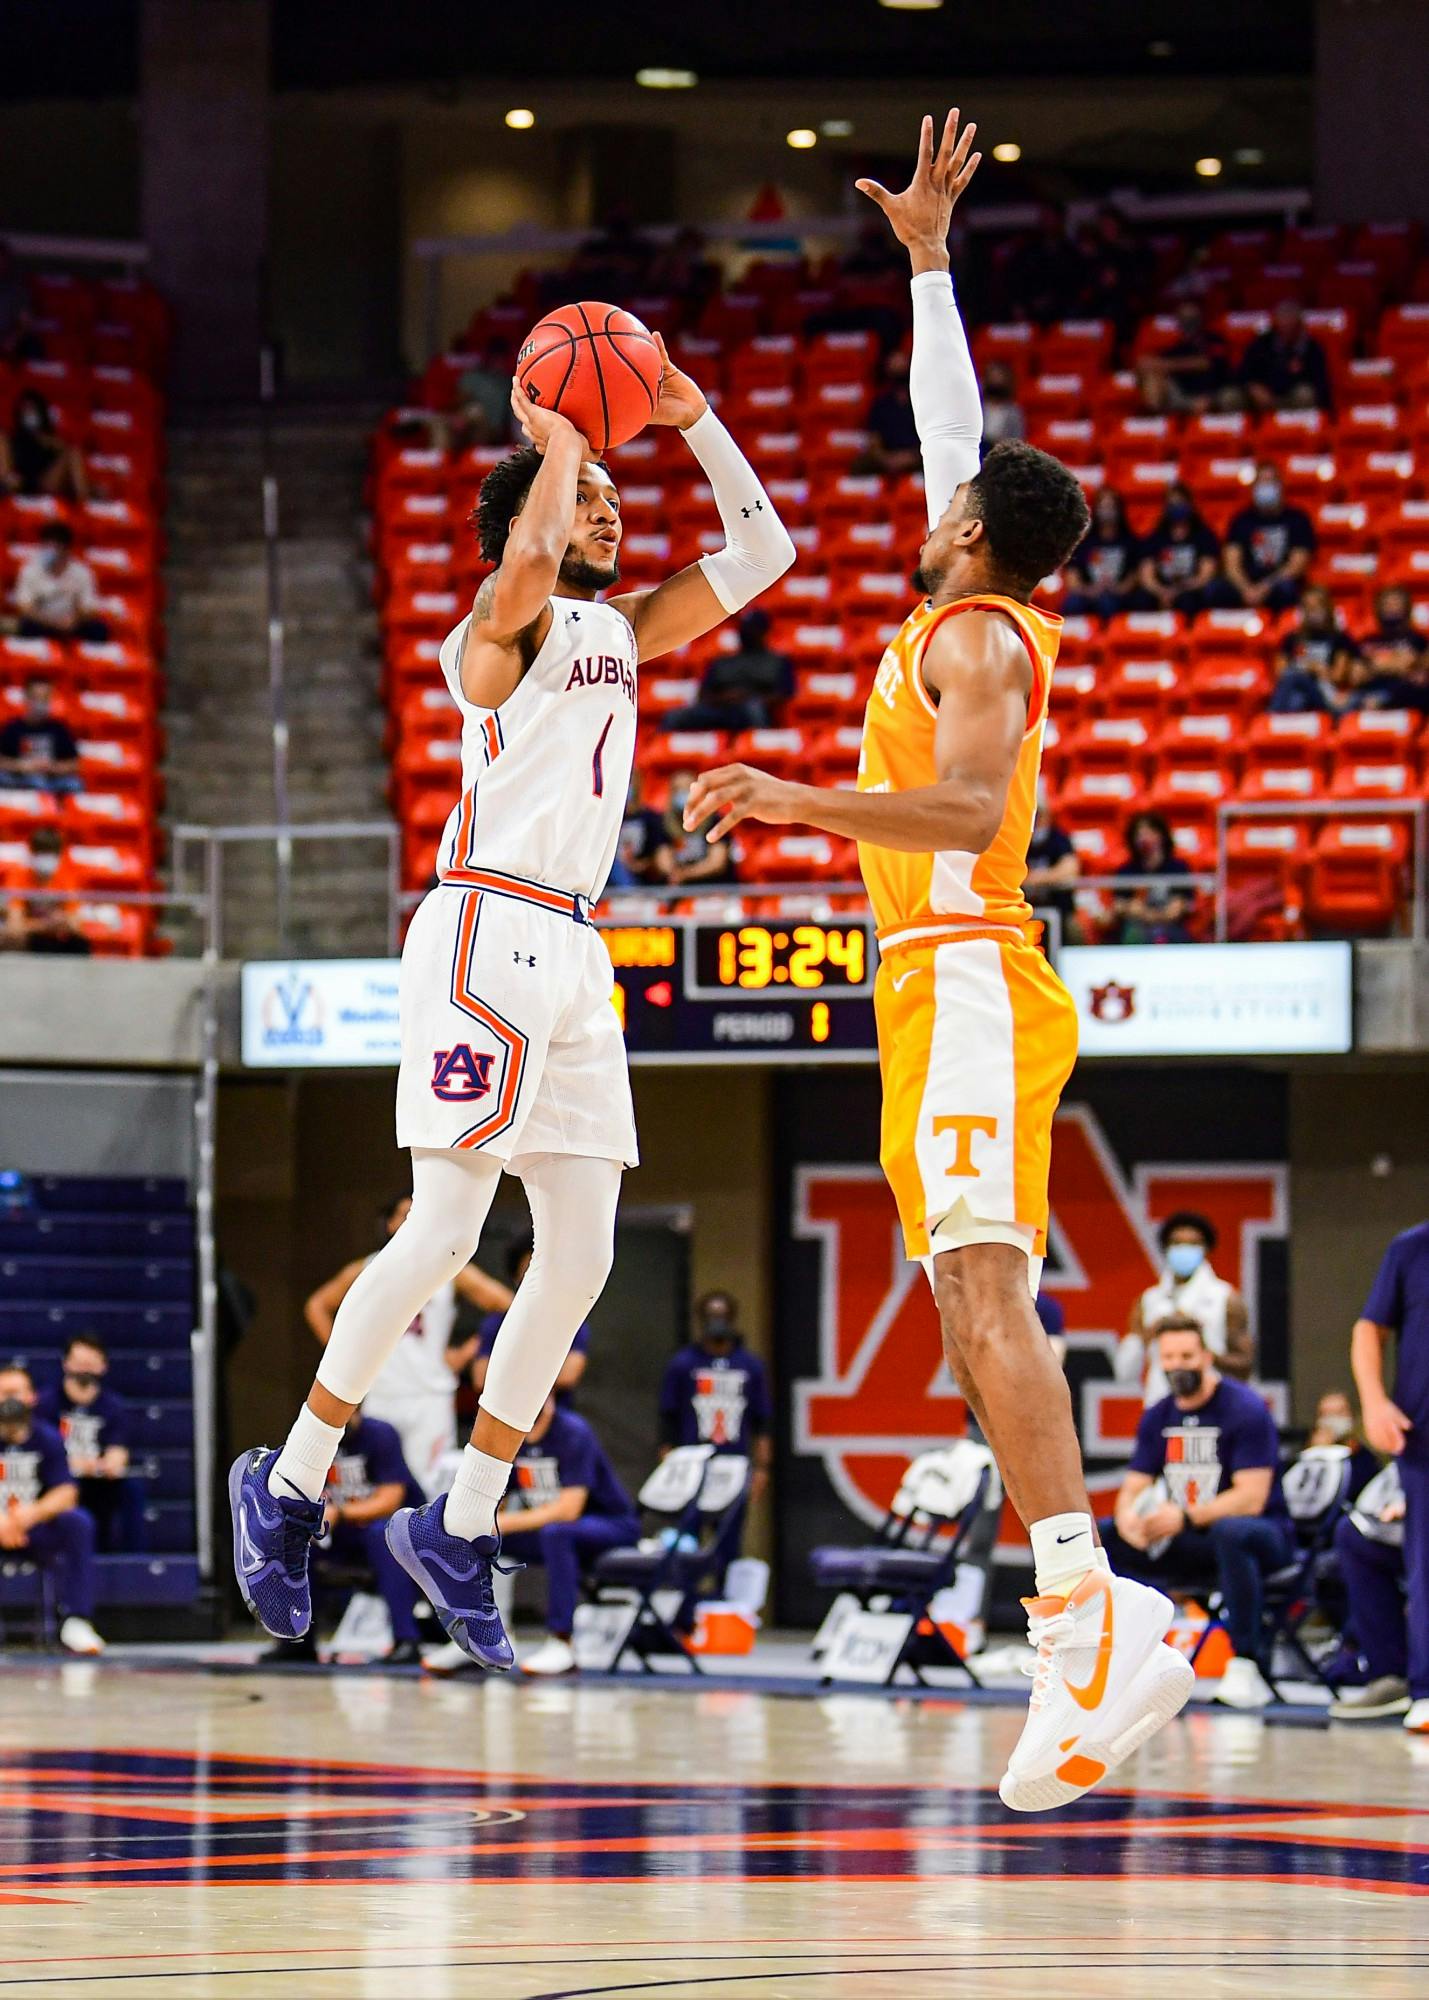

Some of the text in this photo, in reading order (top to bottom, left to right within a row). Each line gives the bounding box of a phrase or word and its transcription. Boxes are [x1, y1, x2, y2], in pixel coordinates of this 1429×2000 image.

[592, 712, 614, 799] 1
[718, 927, 865, 989] 13:24
[712, 1002, 830, 1043] PERIOD 1
[932, 1114, 998, 1178] T
